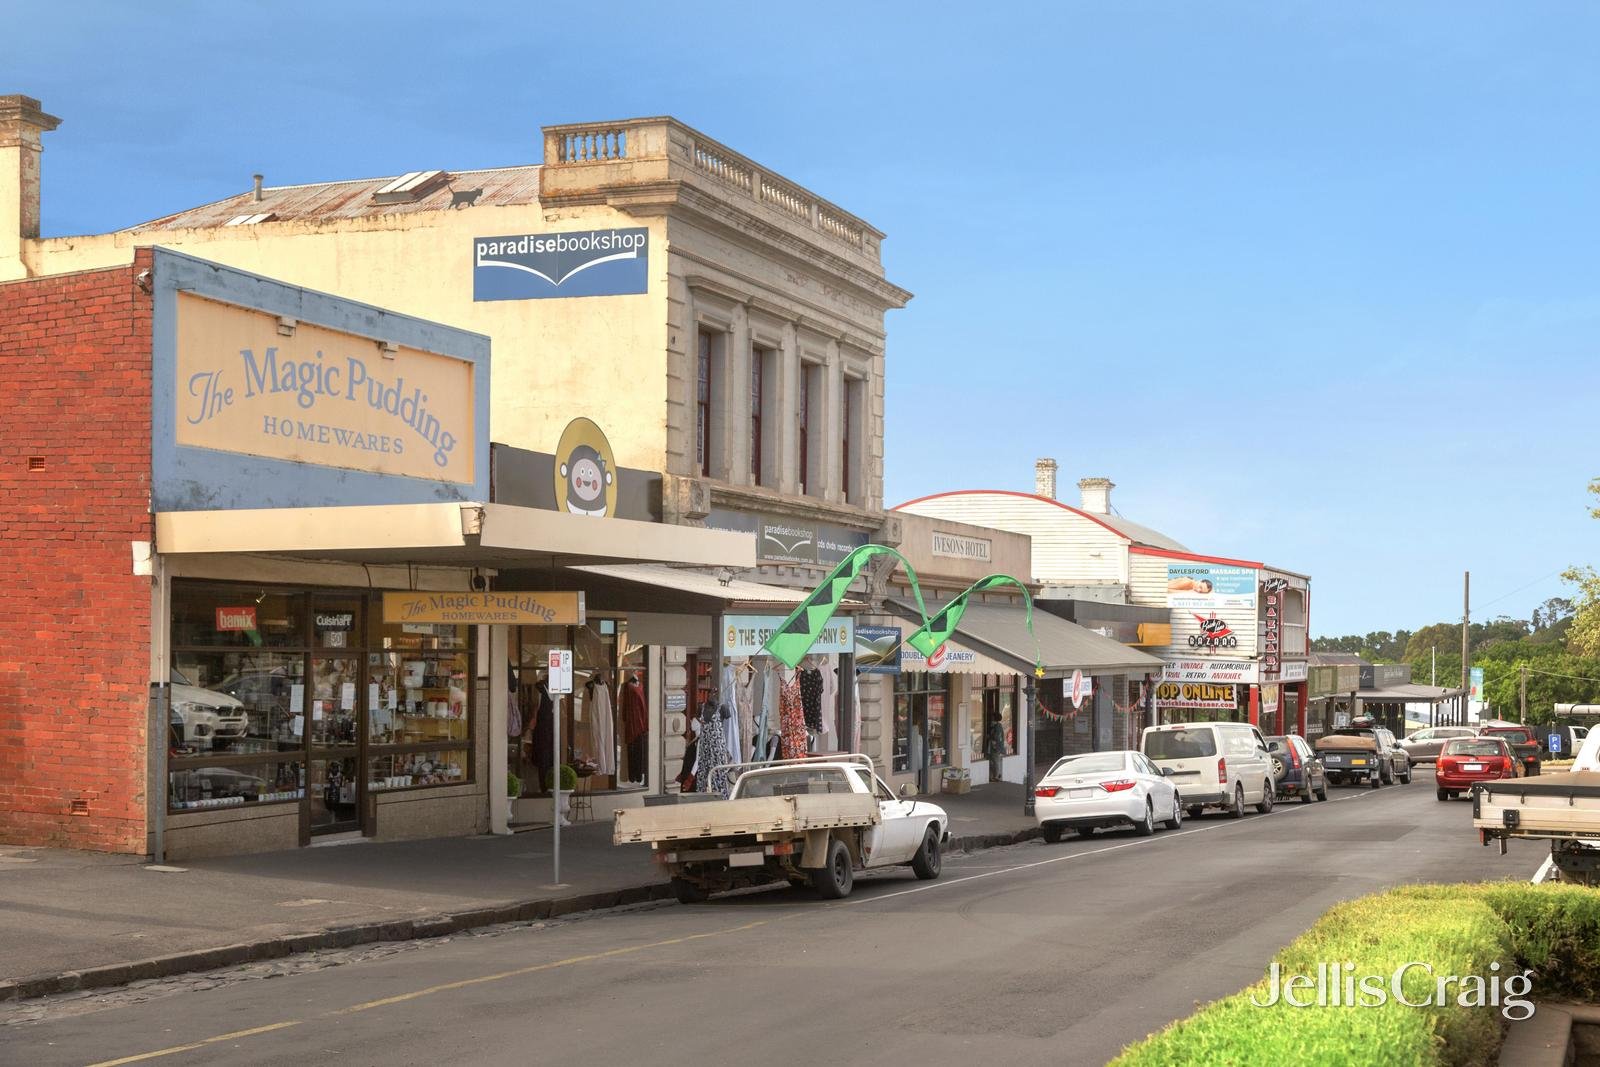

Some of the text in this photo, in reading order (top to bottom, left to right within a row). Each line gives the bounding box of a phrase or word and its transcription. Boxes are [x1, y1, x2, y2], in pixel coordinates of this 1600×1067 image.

[477, 231, 645, 259] paradisebookshop
[186, 347, 457, 467] The Magic Pudding
[263, 415, 404, 454] HOMEWARES
[965, 540, 987, 558] HOTEL
[401, 593, 557, 622] The Magic Pudding
[442, 612, 518, 621] HOMEWARES
[219, 610, 253, 629] bamix
[738, 628, 755, 646] THE
[1189, 635, 1237, 648] BAZAAR
[946, 652, 974, 661] JEANERY
[1185, 671, 1207, 679] RETRO
[1182, 683, 1235, 701] ONLINE
[1156, 700, 1235, 708] .bricklanebazaar.com
